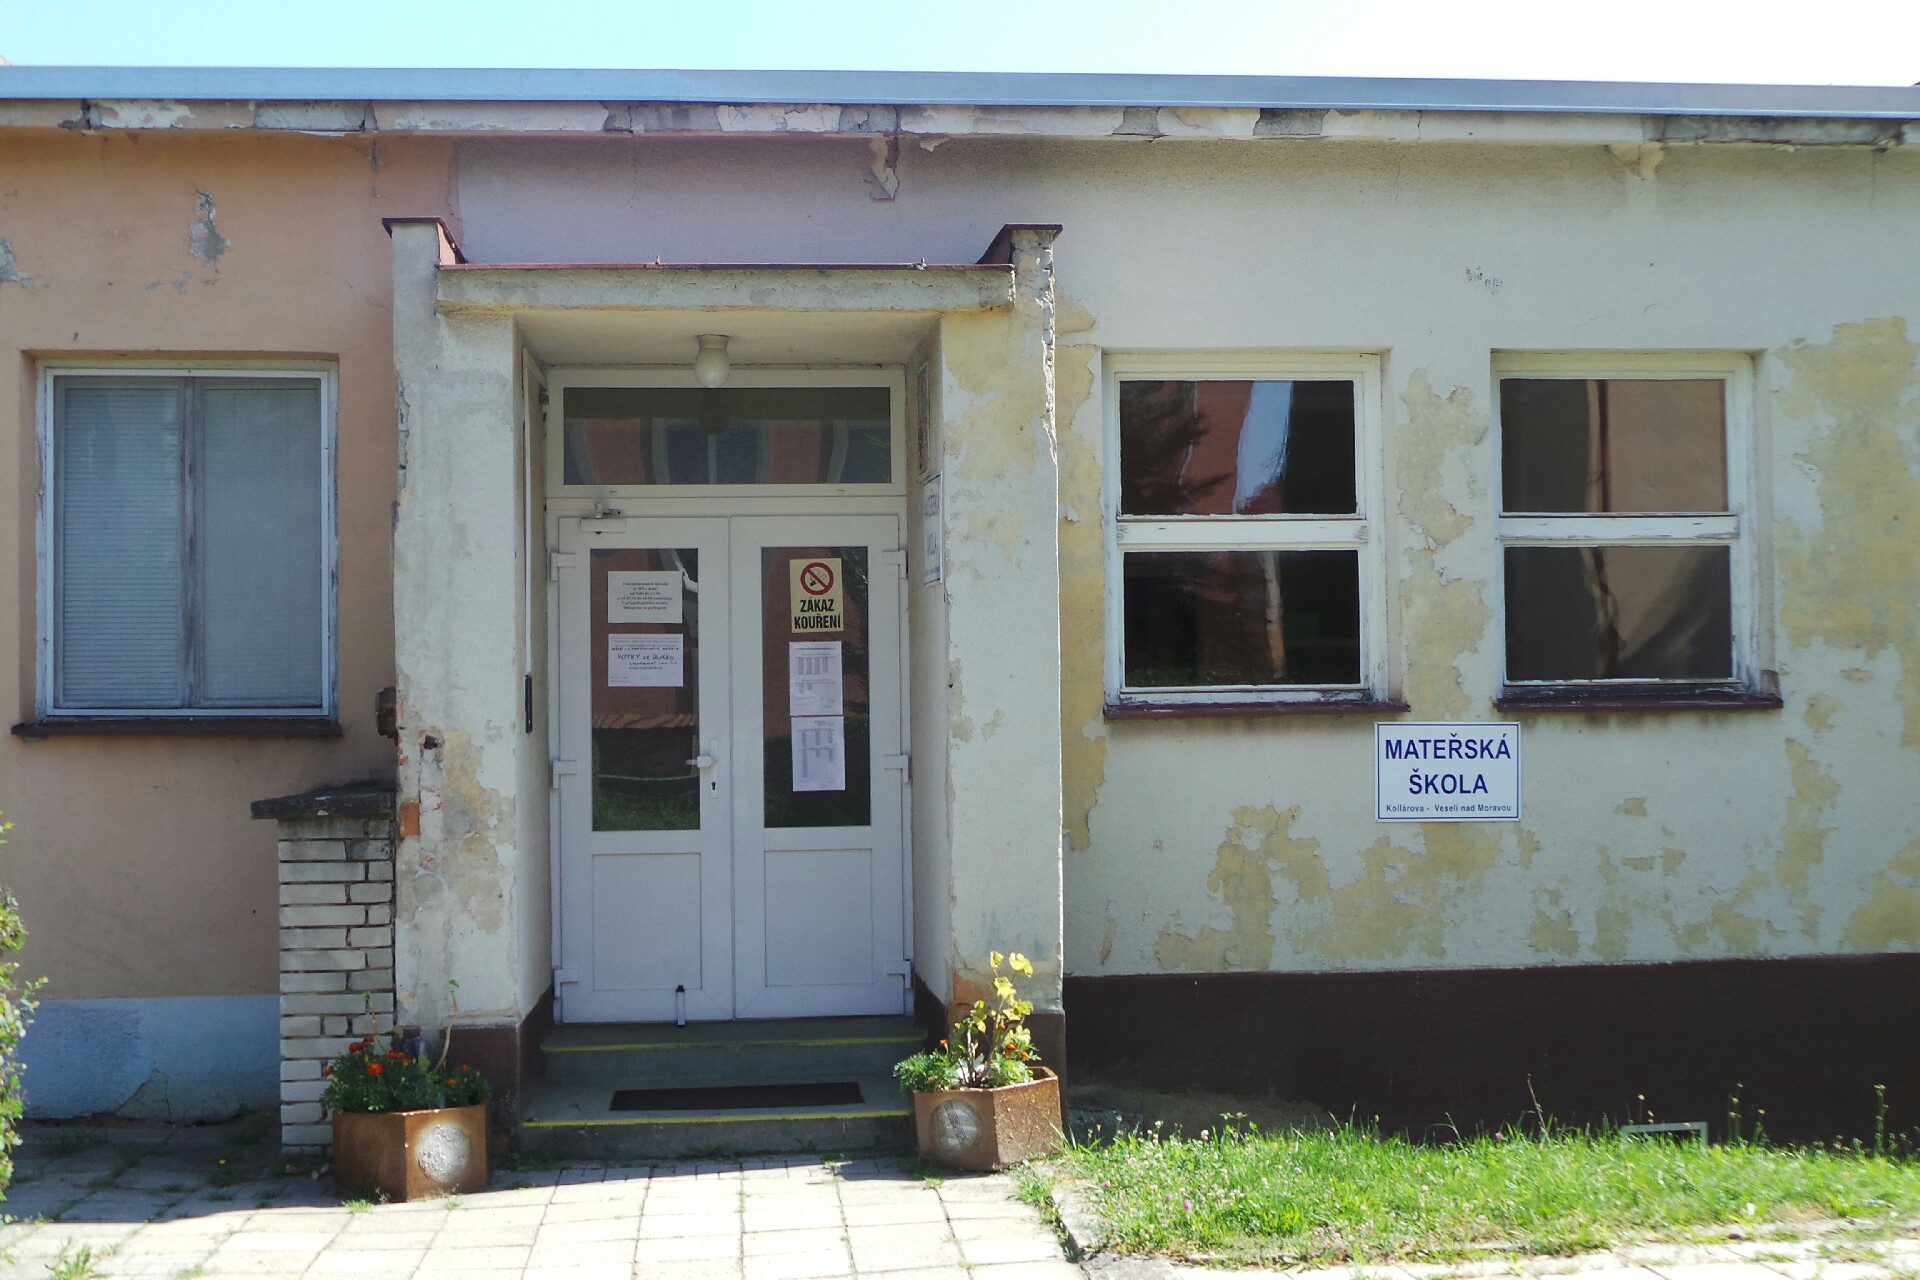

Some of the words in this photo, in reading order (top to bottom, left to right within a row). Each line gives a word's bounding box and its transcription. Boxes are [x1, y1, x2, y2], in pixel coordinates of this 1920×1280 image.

[800, 596, 834, 613] ZÁKAZ
[794, 612, 841, 630] KOUŘENÍ
[1385, 733, 1512, 760] MATEŘSKÁ
[1408, 768, 1489, 795] ŠKOLA
[1386, 804, 1425, 812] Kollárova
[1434, 804, 1458, 812] Veselí
[1461, 804, 1475, 812] nad
[1477, 804, 1512, 812] Moravou
